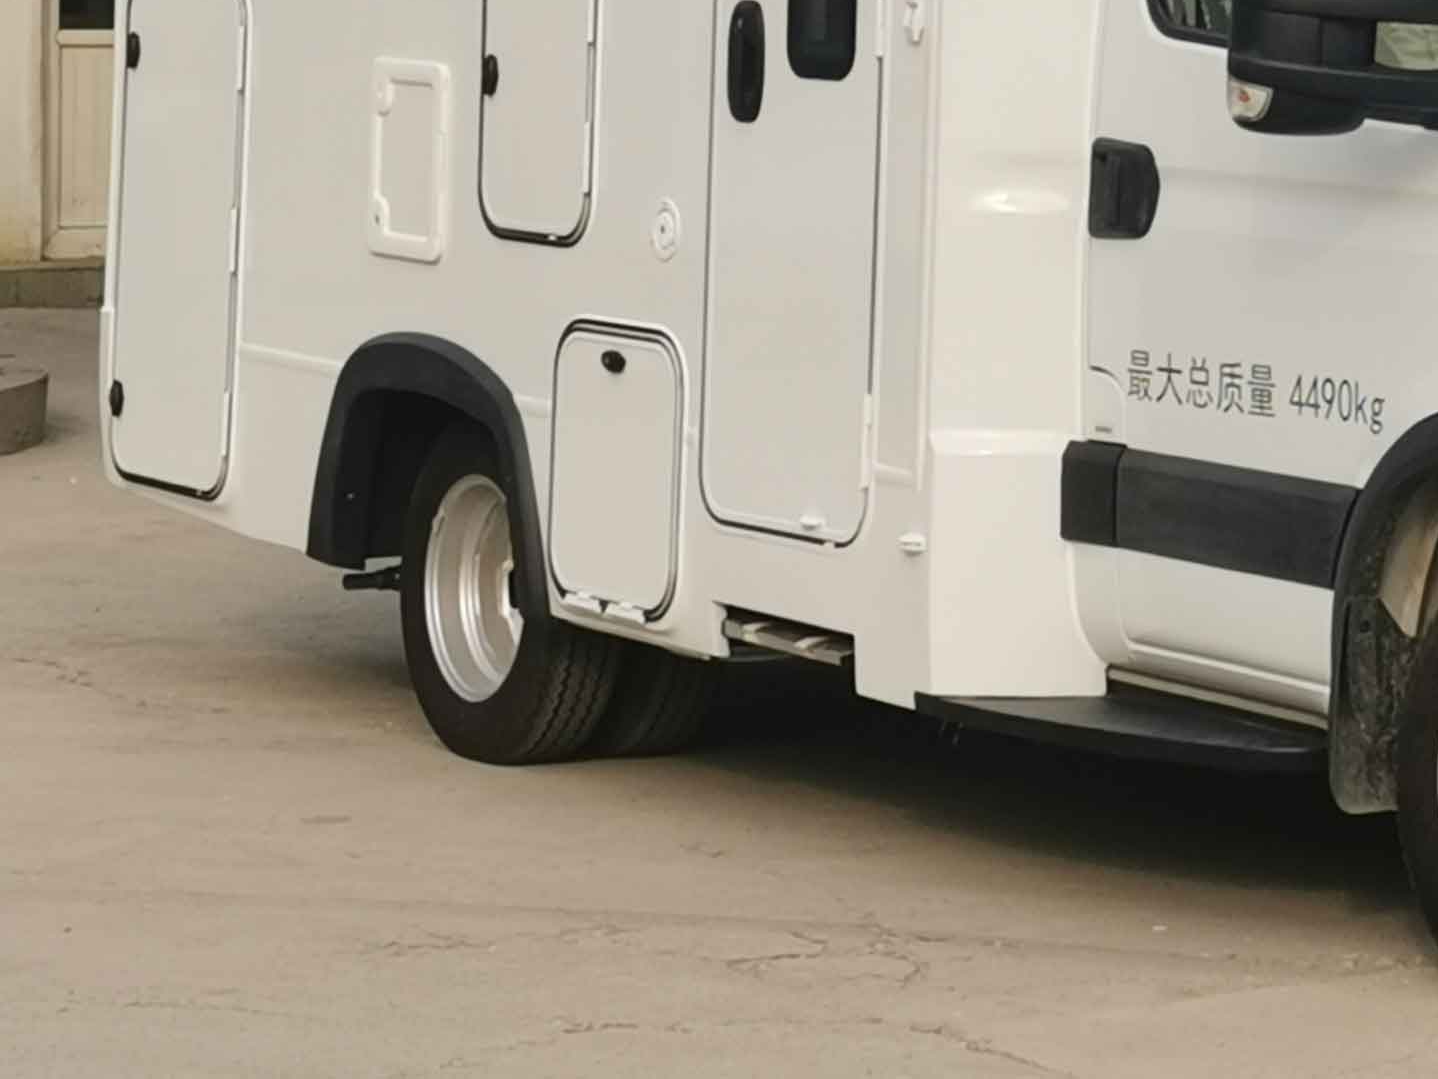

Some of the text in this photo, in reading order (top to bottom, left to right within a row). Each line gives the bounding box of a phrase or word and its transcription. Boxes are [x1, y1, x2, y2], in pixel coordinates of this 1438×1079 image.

[1127, 349, 1385, 435] 最大总质量 4490kg
